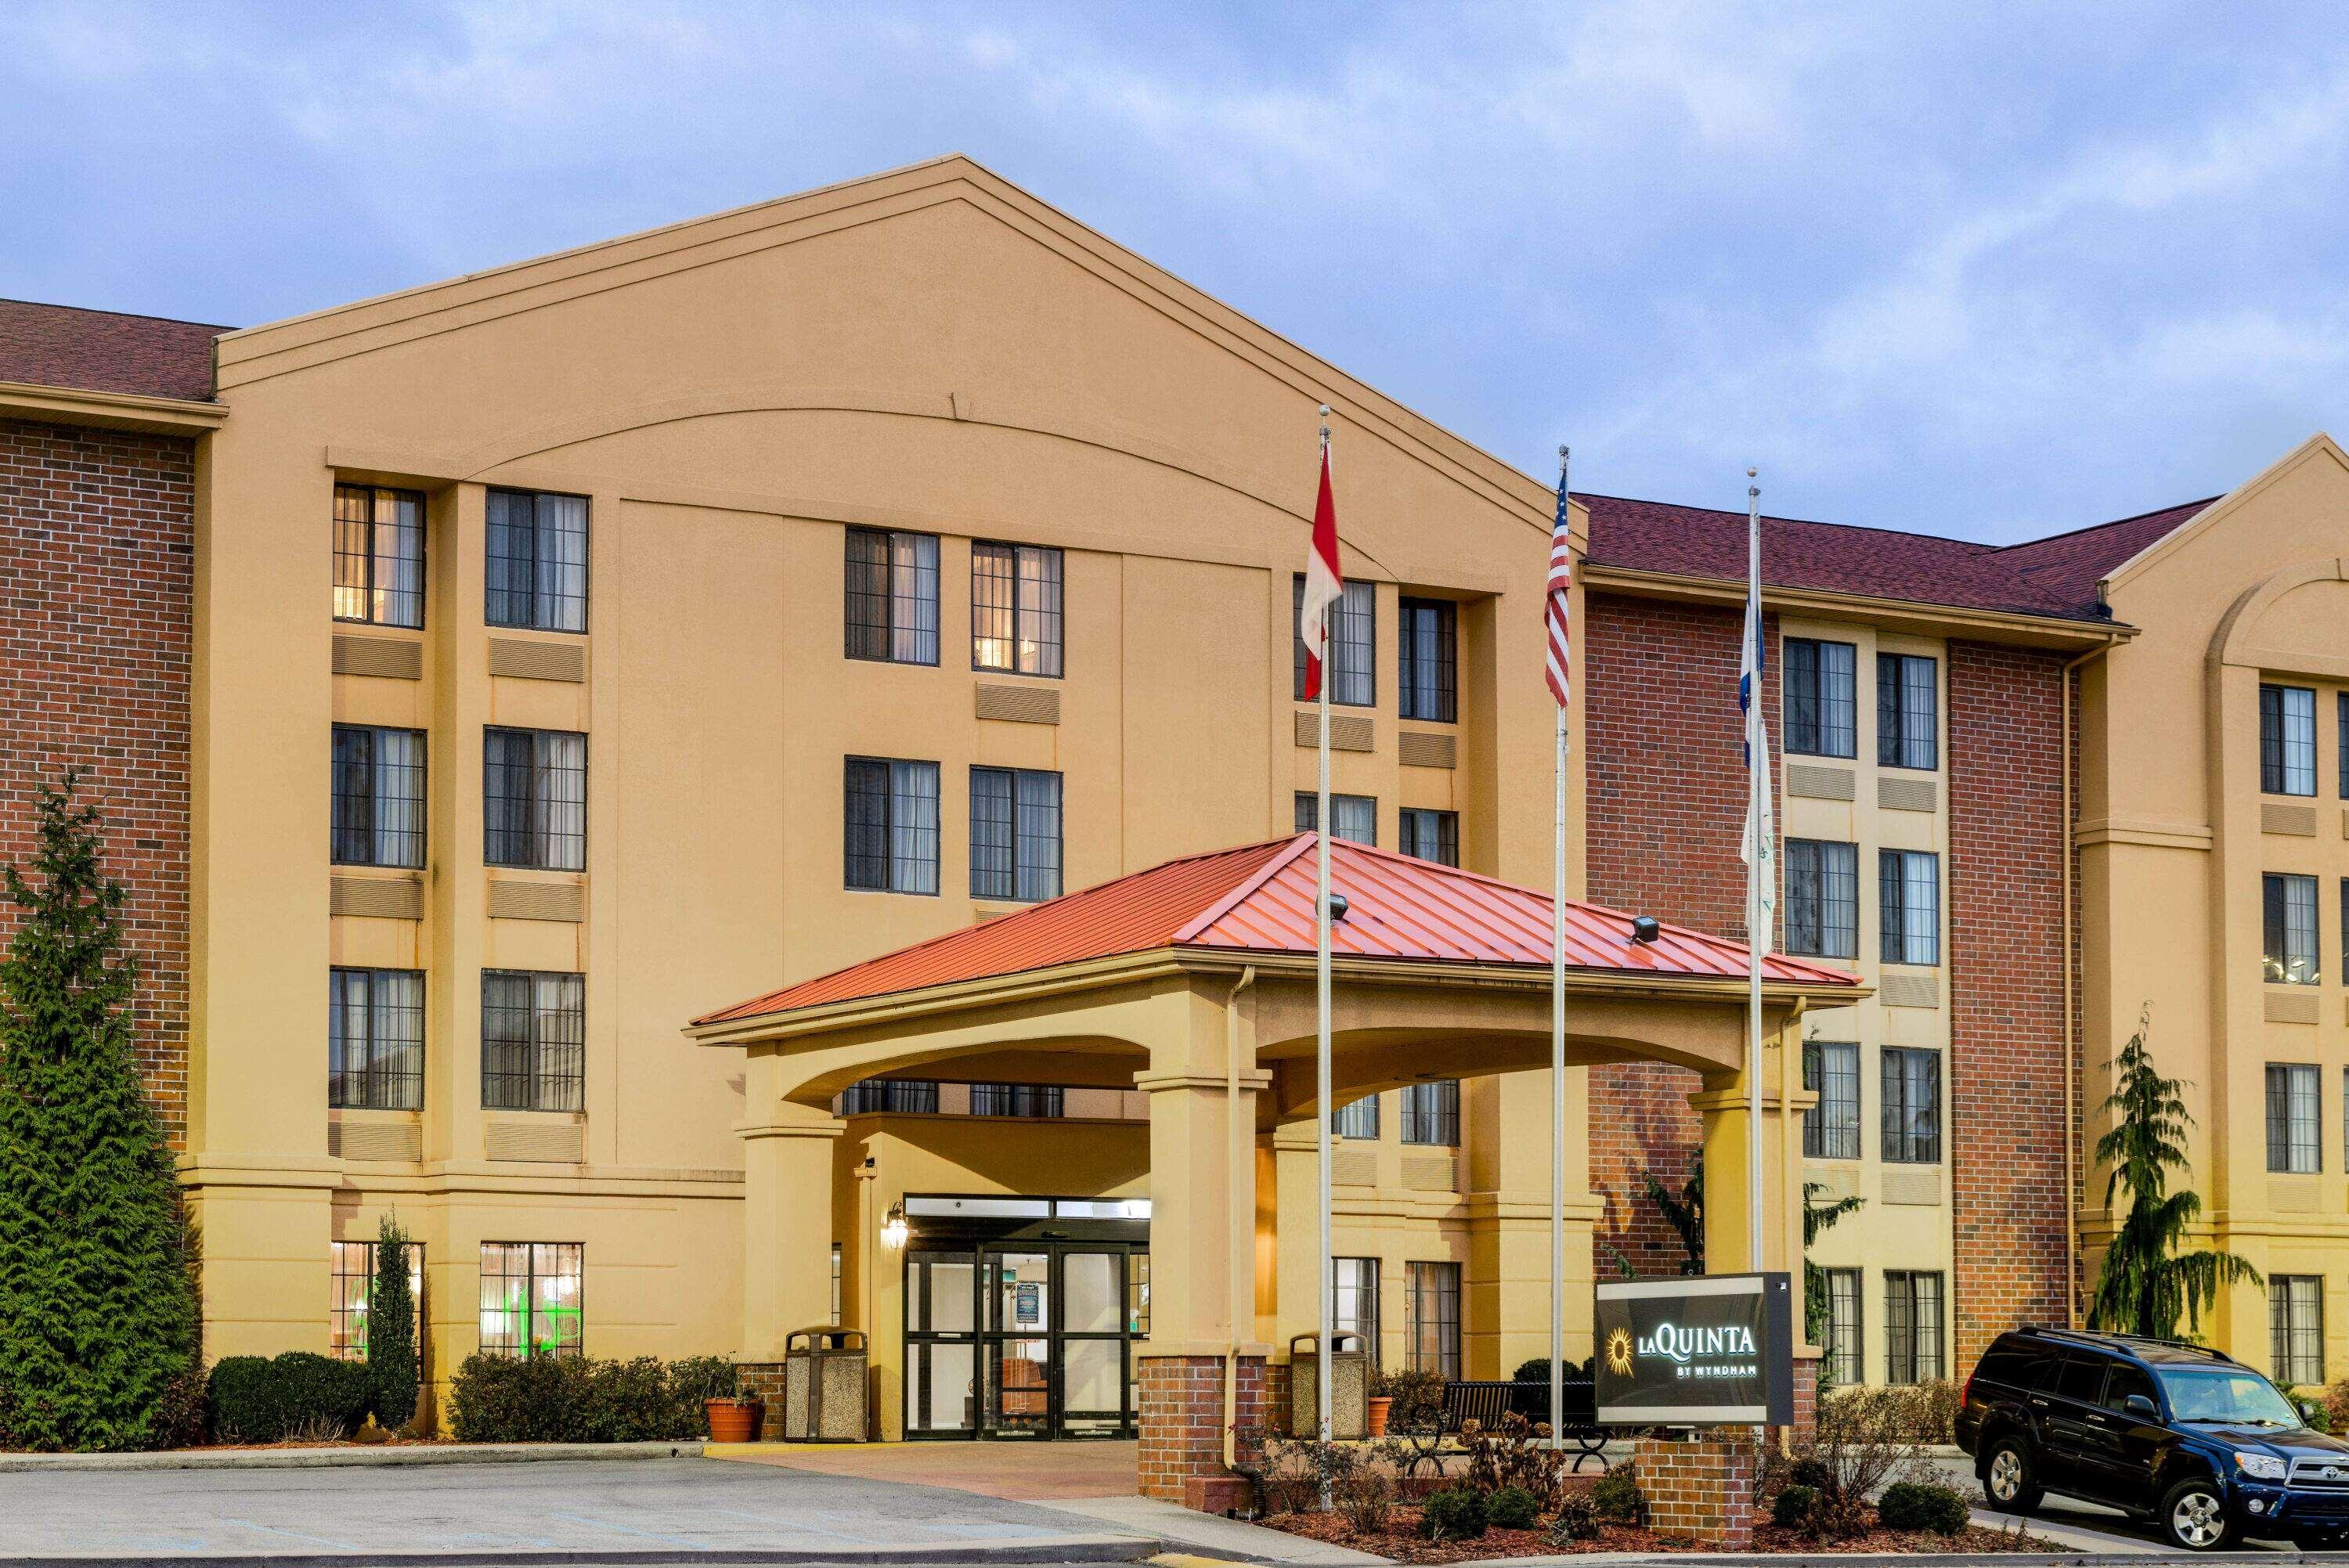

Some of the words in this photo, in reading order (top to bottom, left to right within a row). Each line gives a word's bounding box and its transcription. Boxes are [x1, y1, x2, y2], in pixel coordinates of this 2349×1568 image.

[1638, 1337, 1656, 1354] LA
[1655, 1322, 1756, 1362] QUINTA
[1677, 1367, 1691, 1378] BY
[1694, 1365, 1756, 1377] WYNDHAM
